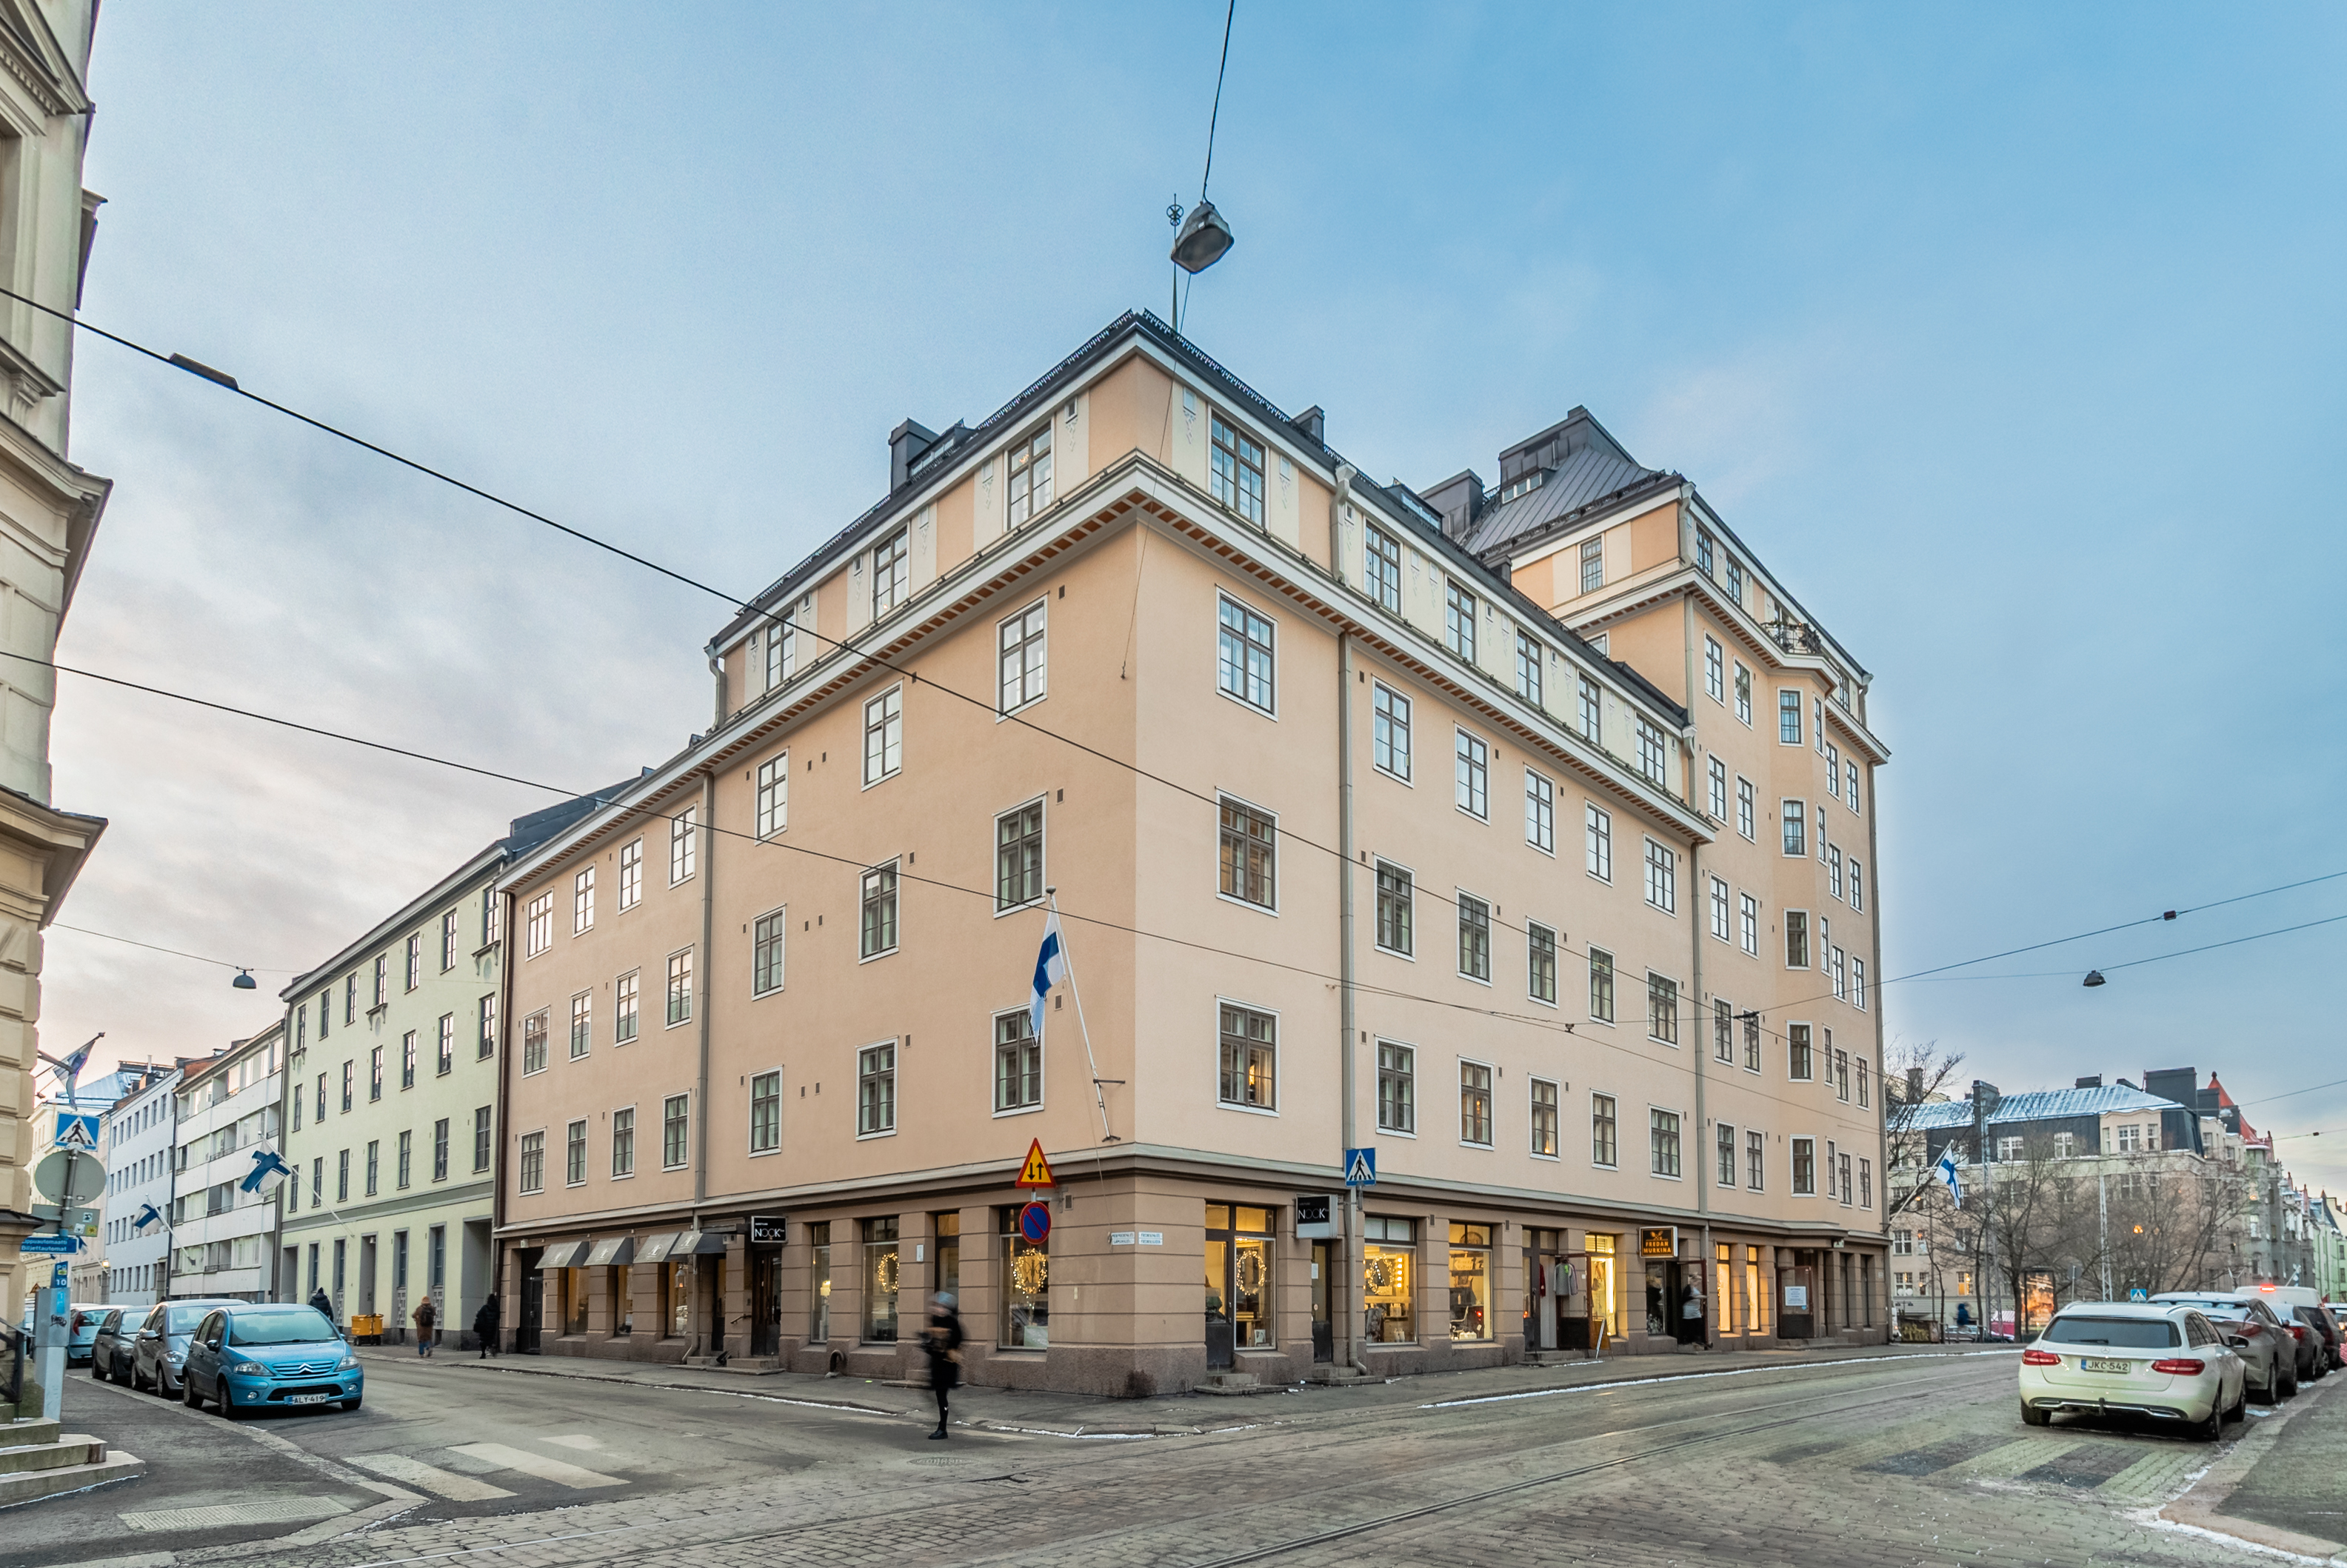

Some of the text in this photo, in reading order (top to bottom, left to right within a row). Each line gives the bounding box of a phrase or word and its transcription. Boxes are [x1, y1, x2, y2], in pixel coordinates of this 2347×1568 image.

[1298, 1208, 1326, 1220] NOOK
[755, 1228, 781, 1238] NOOK
[2089, 1361, 2129, 1372] JKC-542
[294, 1395, 326, 1404] ALY-419
